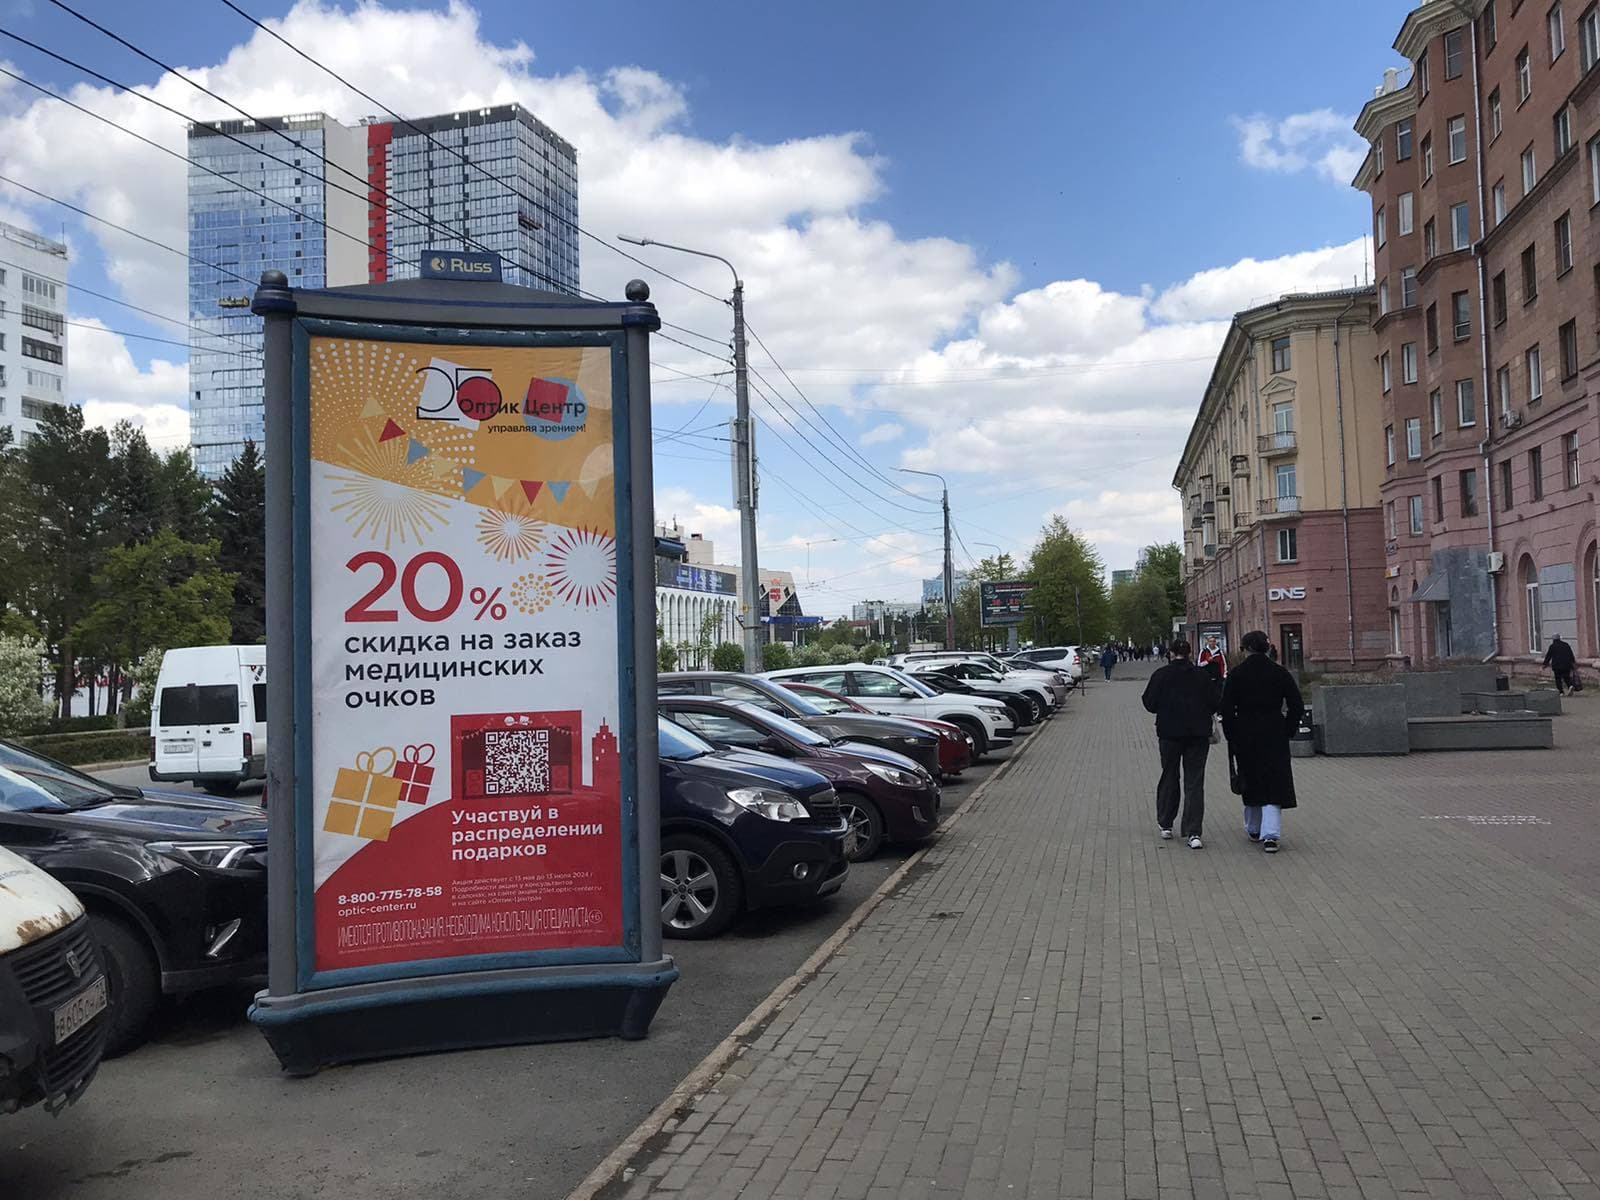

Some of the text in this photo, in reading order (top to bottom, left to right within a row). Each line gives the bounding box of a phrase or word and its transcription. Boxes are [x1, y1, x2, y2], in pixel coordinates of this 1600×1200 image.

[450, 258, 492, 273] Russ
[460, 398, 586, 417] Оптик Центр
[487, 422, 587, 434] управляя зрением!
[344, 550, 507, 623] 20%
[1269, 587, 1306, 601] DNS
[344, 631, 582, 655] скидка на заказ
[344, 658, 544, 682] медицинских
[344, 689, 436, 708] очков
[451, 805, 559, 824] Участвуй в
[451, 824, 603, 844] распределении
[452, 844, 547, 861] подарков
[338, 885, 443, 905] 8-800-775-78-58
[338, 901, 417, 918] optic-center.ru
